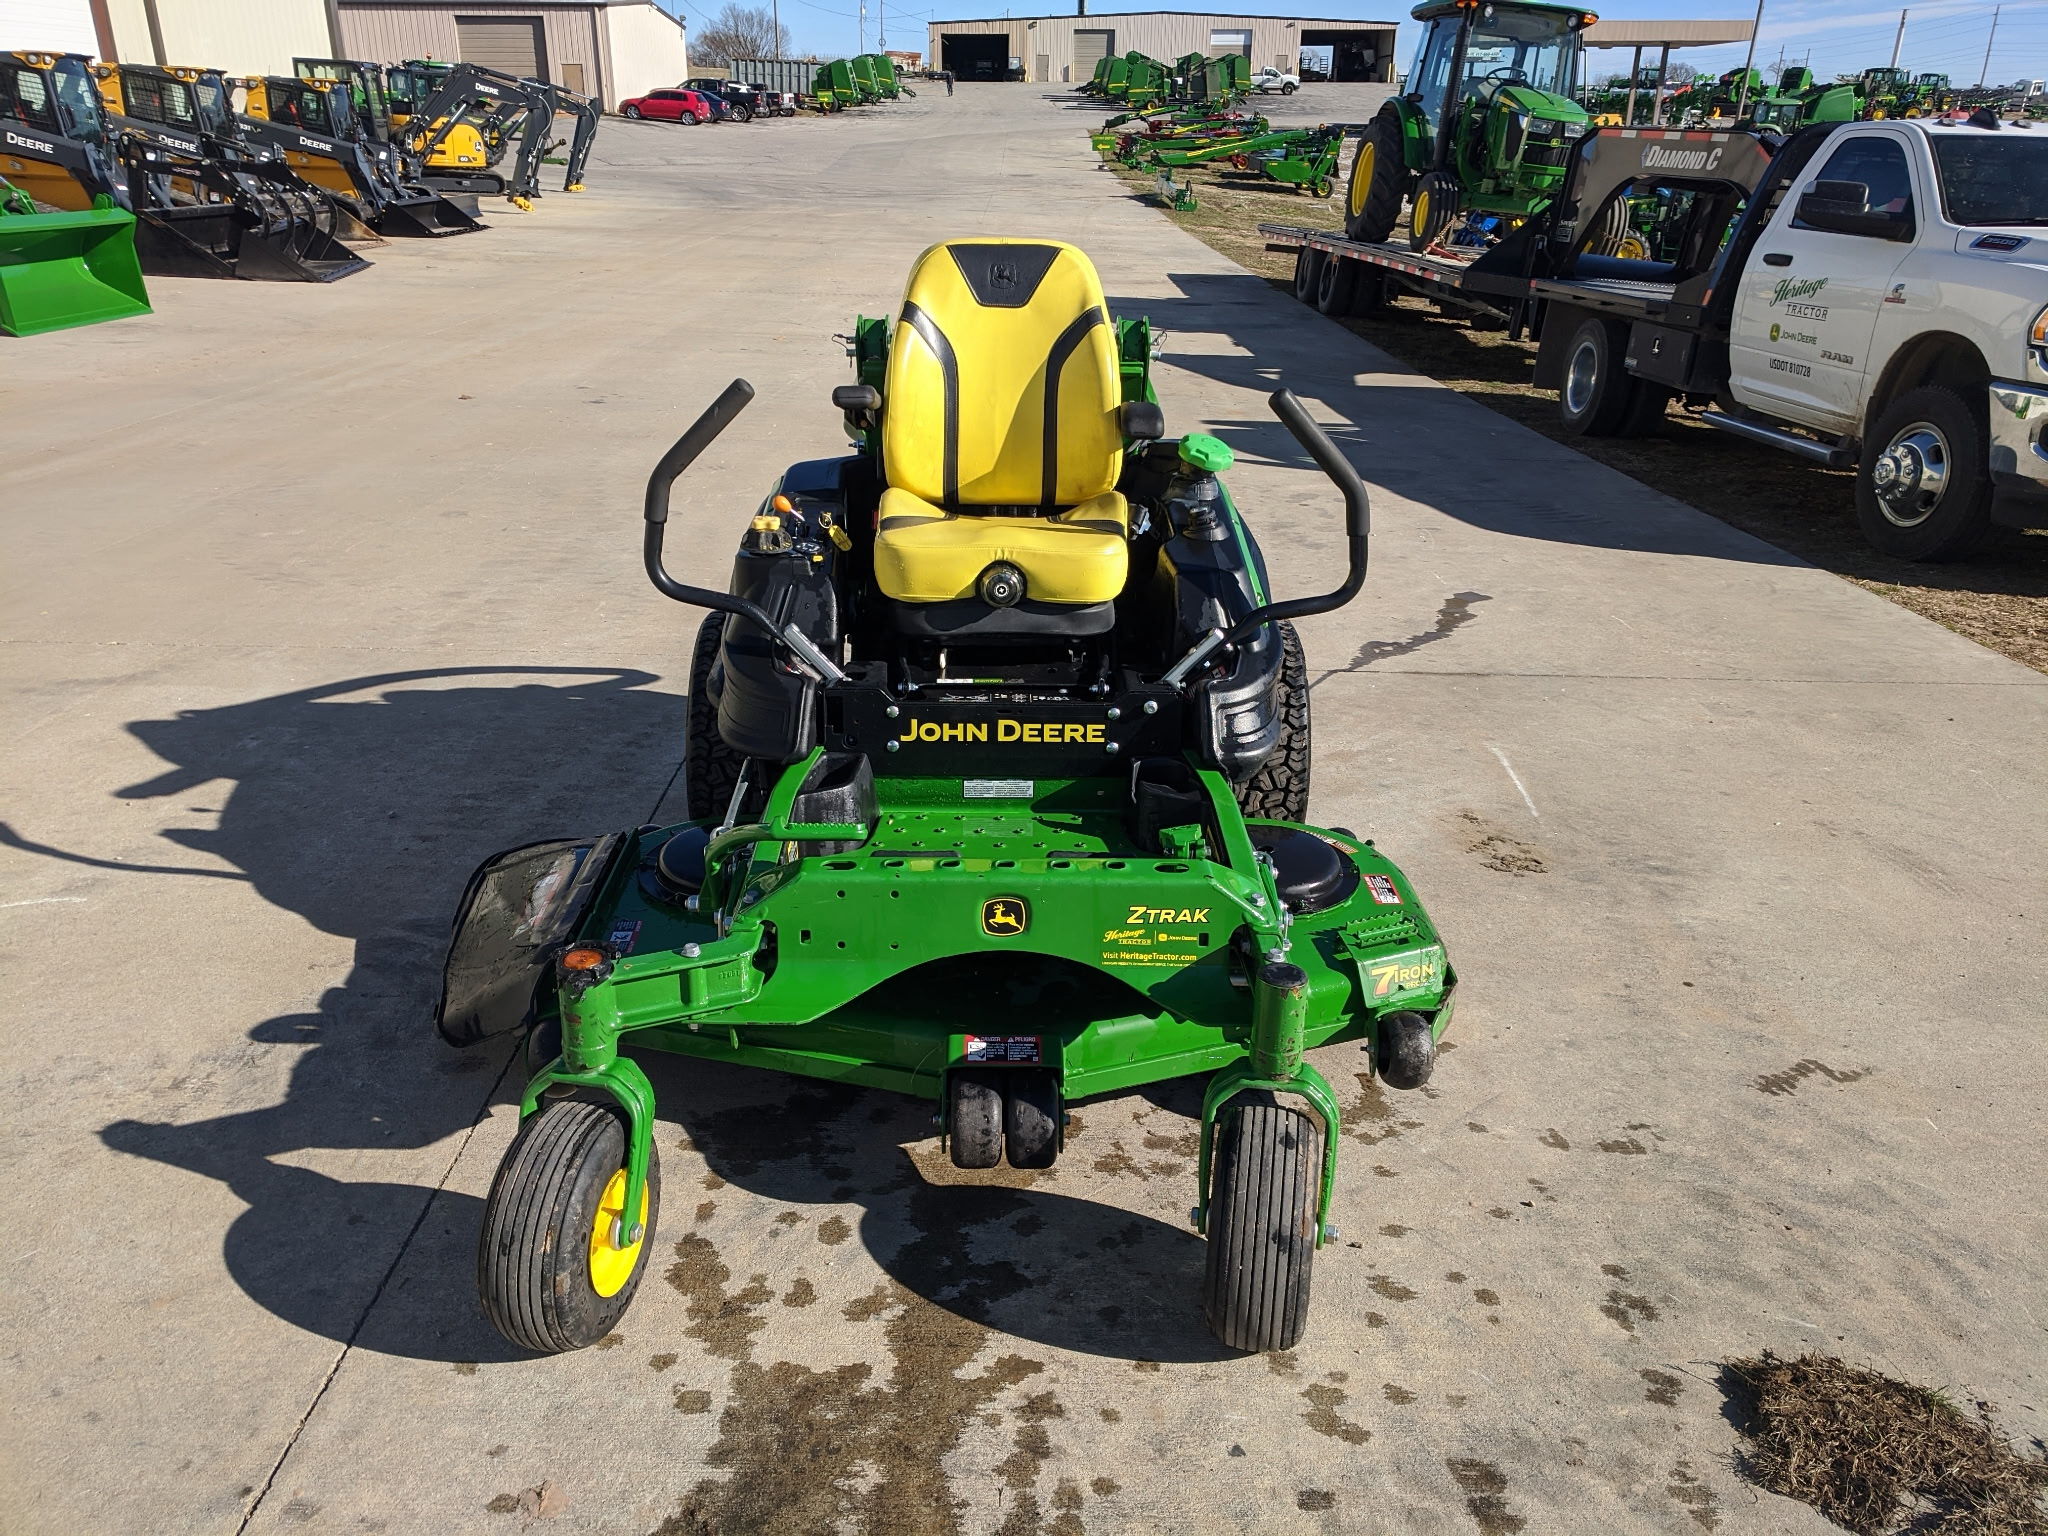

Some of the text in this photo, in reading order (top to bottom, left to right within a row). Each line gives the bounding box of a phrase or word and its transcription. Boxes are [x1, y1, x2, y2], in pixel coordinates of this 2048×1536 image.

[475, 82, 499, 96] DEERE
[7, 132, 54, 154] DEERE
[158, 134, 197, 152] DEERE
[299, 136, 333, 152] DEERE
[1646, 145, 1722, 170] DIAMOND C
[1769, 275, 1829, 307] Heritage
[1786, 304, 1828, 320] TRACTOR
[1780, 329, 1818, 345] JOHN DEERE
[1820, 350, 1854, 365] RAM
[1769, 358, 1811, 378] USDOT 810728
[900, 718, 1106, 743] JOHN DEERE
[1126, 905, 1211, 924] ZTRAK
[1103, 929, 1146, 942] Heritage
[1102, 951, 1197, 962] Visit HeritageTractor.com
